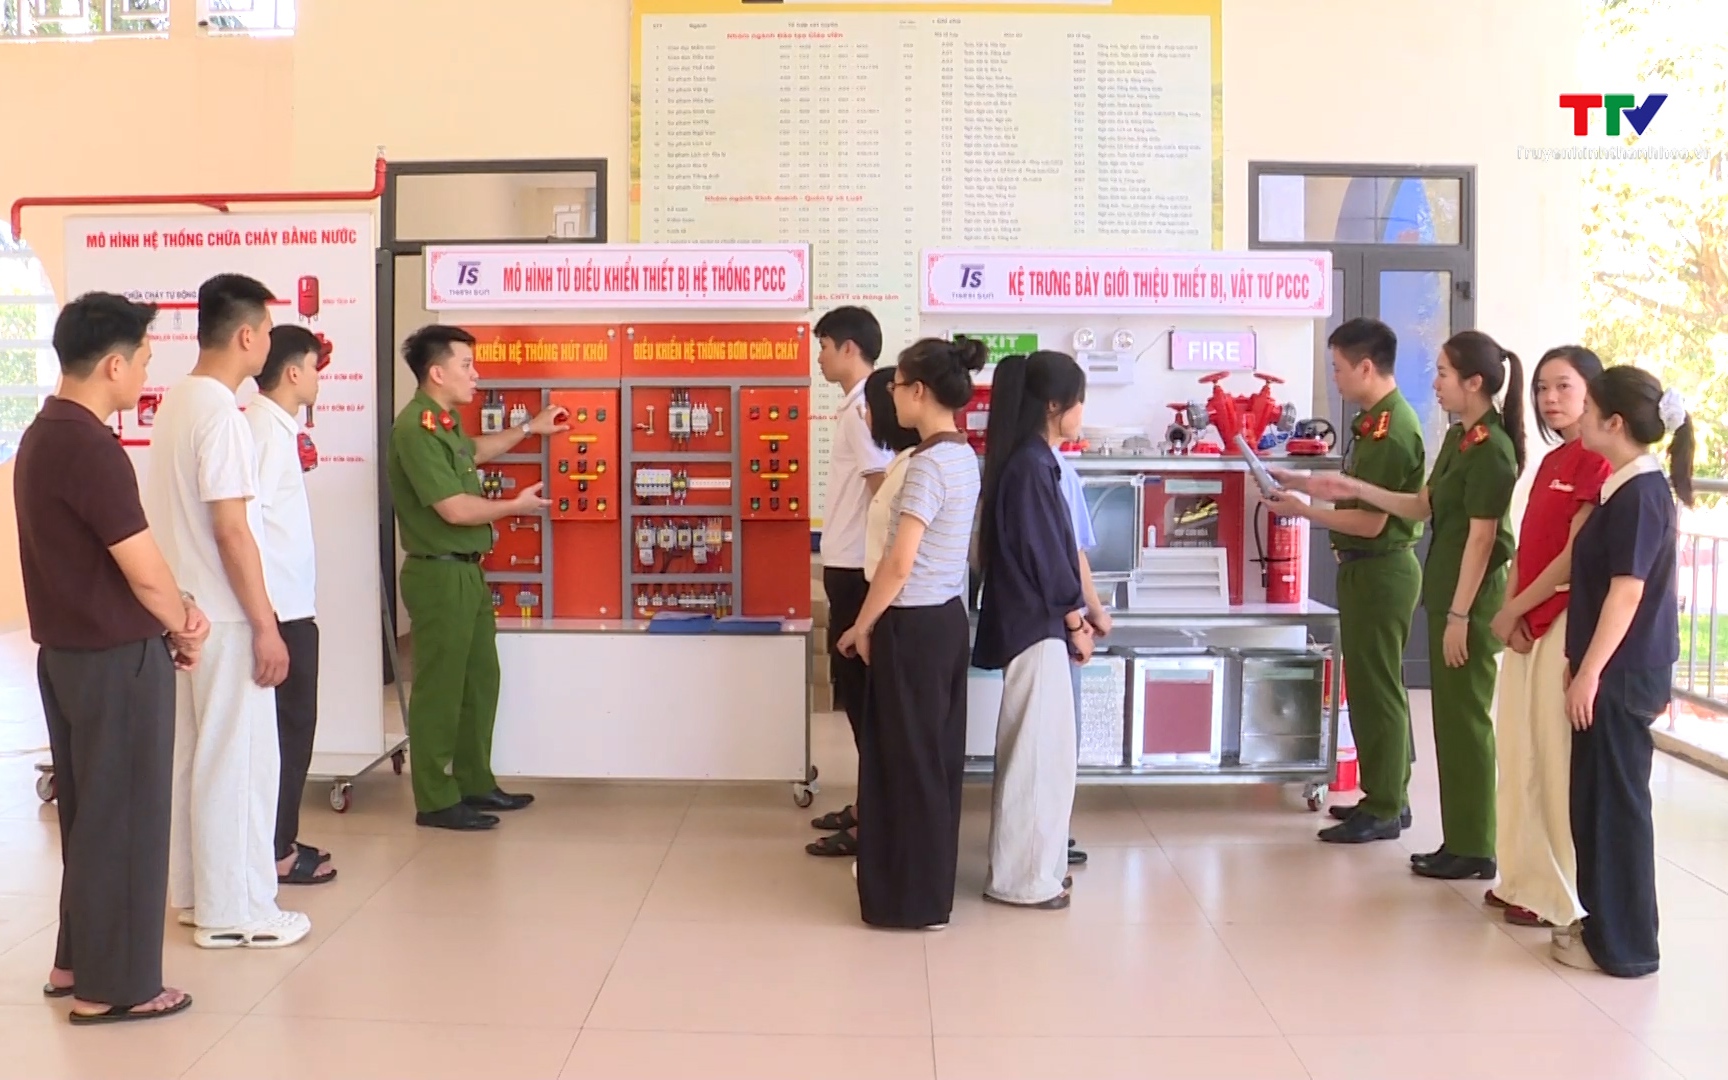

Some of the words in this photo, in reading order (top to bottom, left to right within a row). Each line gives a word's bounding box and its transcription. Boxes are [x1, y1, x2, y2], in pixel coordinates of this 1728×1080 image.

[86, 232, 106, 248] MÔ
[109, 230, 139, 248] HÌNH
[143, 230, 158, 251] HỆ
[164, 228, 204, 248] THỐNG
[207, 229, 242, 246] CHỮA
[245, 228, 278, 246] CHÁY
[282, 226, 317, 244] BẰNG
[321, 227, 356, 244] NƯỚC
[503, 262, 522, 292] MÔ
[525, 262, 553, 292] HÌNH
[556, 258, 570, 292] TỦ
[574, 258, 600, 292] ĐIỀU
[604, 256, 640, 292] KHIỂN
[643, 258, 674, 292] THIẾT
[678, 265, 690, 297] BỊ
[693, 260, 708, 297] HỆ
[712, 256, 750, 292] THỐNG
[754, 265, 786, 292] PCCC
[1009, 265, 1025, 301] KỆ
[1029, 269, 1071, 297] TRƯNG
[1075, 266, 1100, 296] BÀY
[1104, 266, 1129, 297] GIỚI
[1134, 266, 1168, 303] THIỆU
[1172, 264, 1206, 298] THIẾT
[1211, 273, 1227, 304] BỊ,
[1232, 267, 1254, 304] VẬT
[1258, 271, 1274, 299] TƯ
[1276, 273, 1310, 300] PCCC
[476, 336, 506, 362] KHIỂN
[508, 340, 522, 365] HỆ
[524, 338, 558, 362] THỐNG
[560, 339, 580, 362] HÚT
[582, 339, 608, 362] KHÓI
[970, 335, 1018, 348] XIT
[1188, 341, 1241, 363] FIRE
